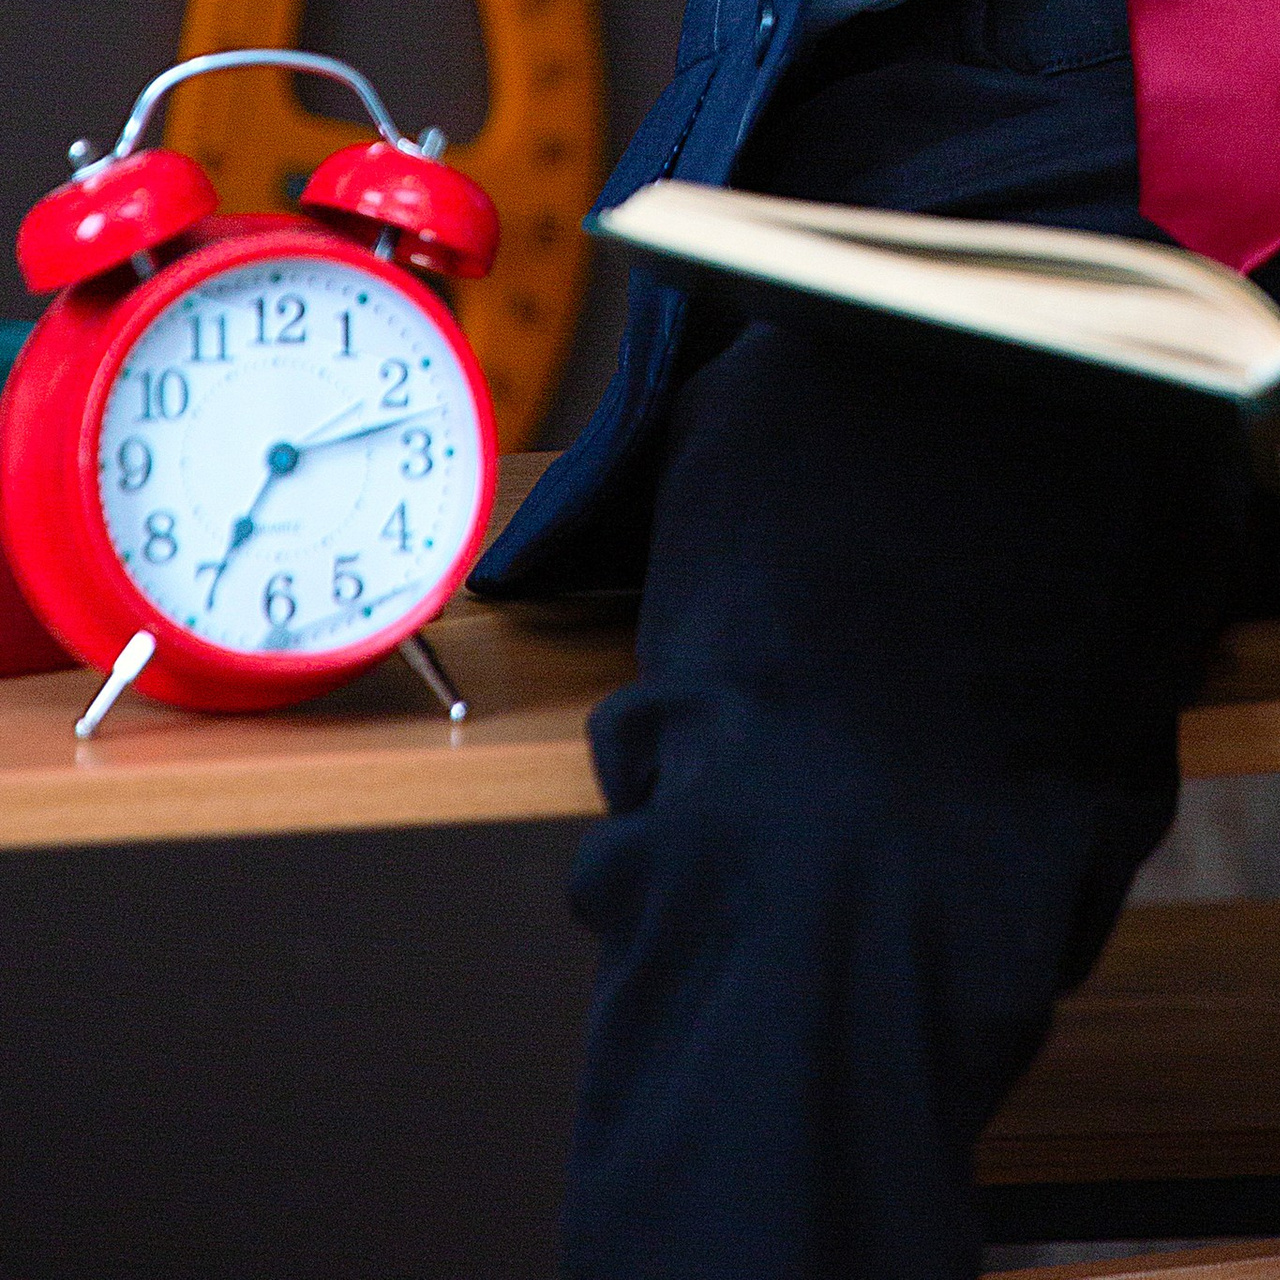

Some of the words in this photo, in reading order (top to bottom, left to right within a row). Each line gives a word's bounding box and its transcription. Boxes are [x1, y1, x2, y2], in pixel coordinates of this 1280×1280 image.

[186, 312, 231, 363] 11
[249, 293, 307, 345] 12
[333, 309, 356, 358] 1
[137, 368, 189, 422] 10
[379, 358, 409, 408] 2
[118, 436, 152, 492] 9
[400, 427, 434, 479] 3
[143, 510, 178, 564] 8
[380, 500, 412, 552] 4
[195, 559, 226, 612] 7
[263, 572, 296, 626] 6
[333, 553, 363, 605] 5
